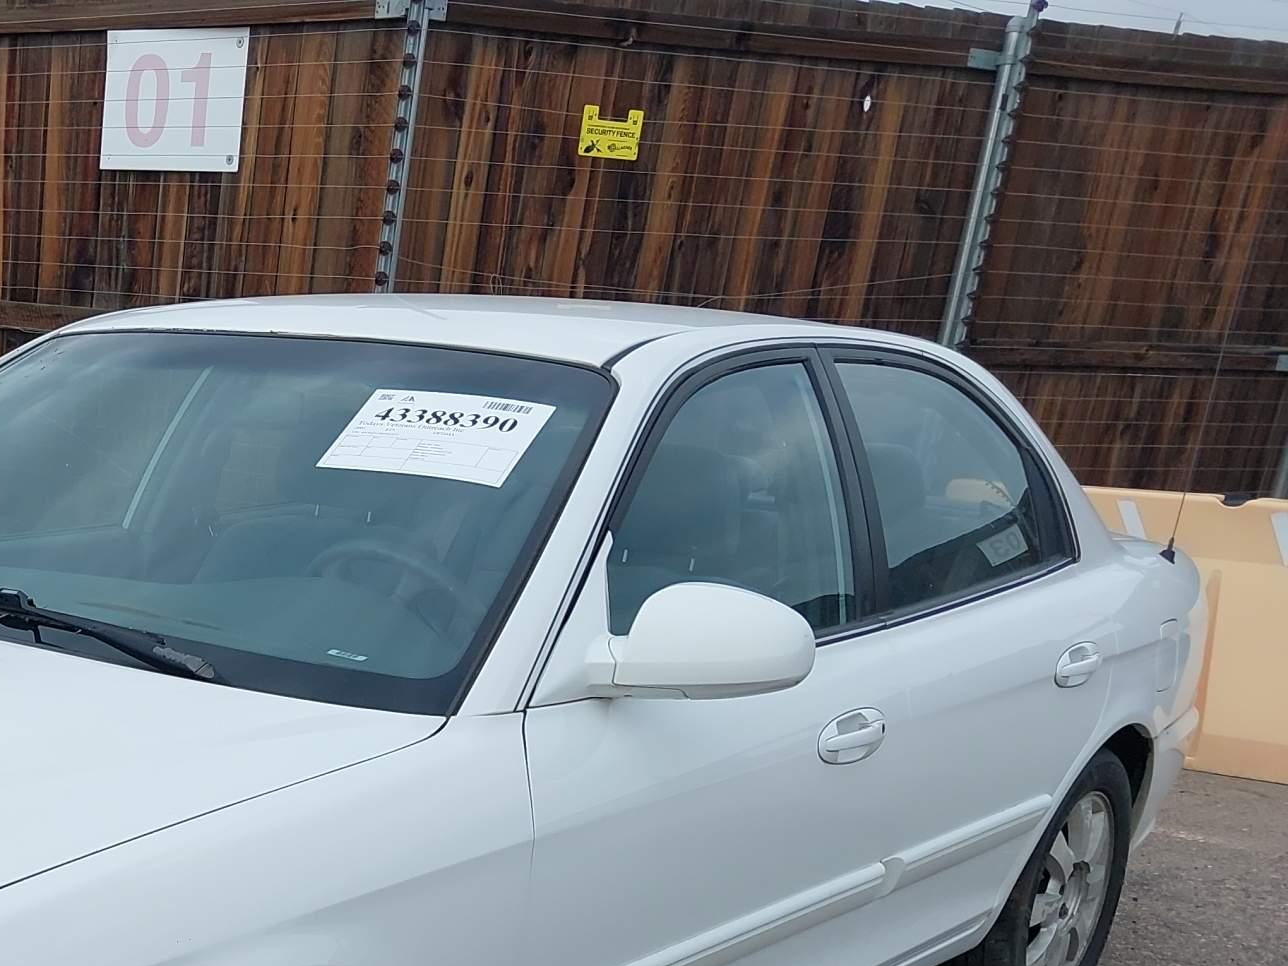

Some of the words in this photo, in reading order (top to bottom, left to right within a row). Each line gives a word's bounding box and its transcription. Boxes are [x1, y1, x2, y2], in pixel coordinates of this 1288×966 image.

[125, 52, 212, 148] 01
[586, 128, 616, 136] SECURITY
[616, 131, 636, 139] FENCE
[374, 407, 518, 433] 43388390
